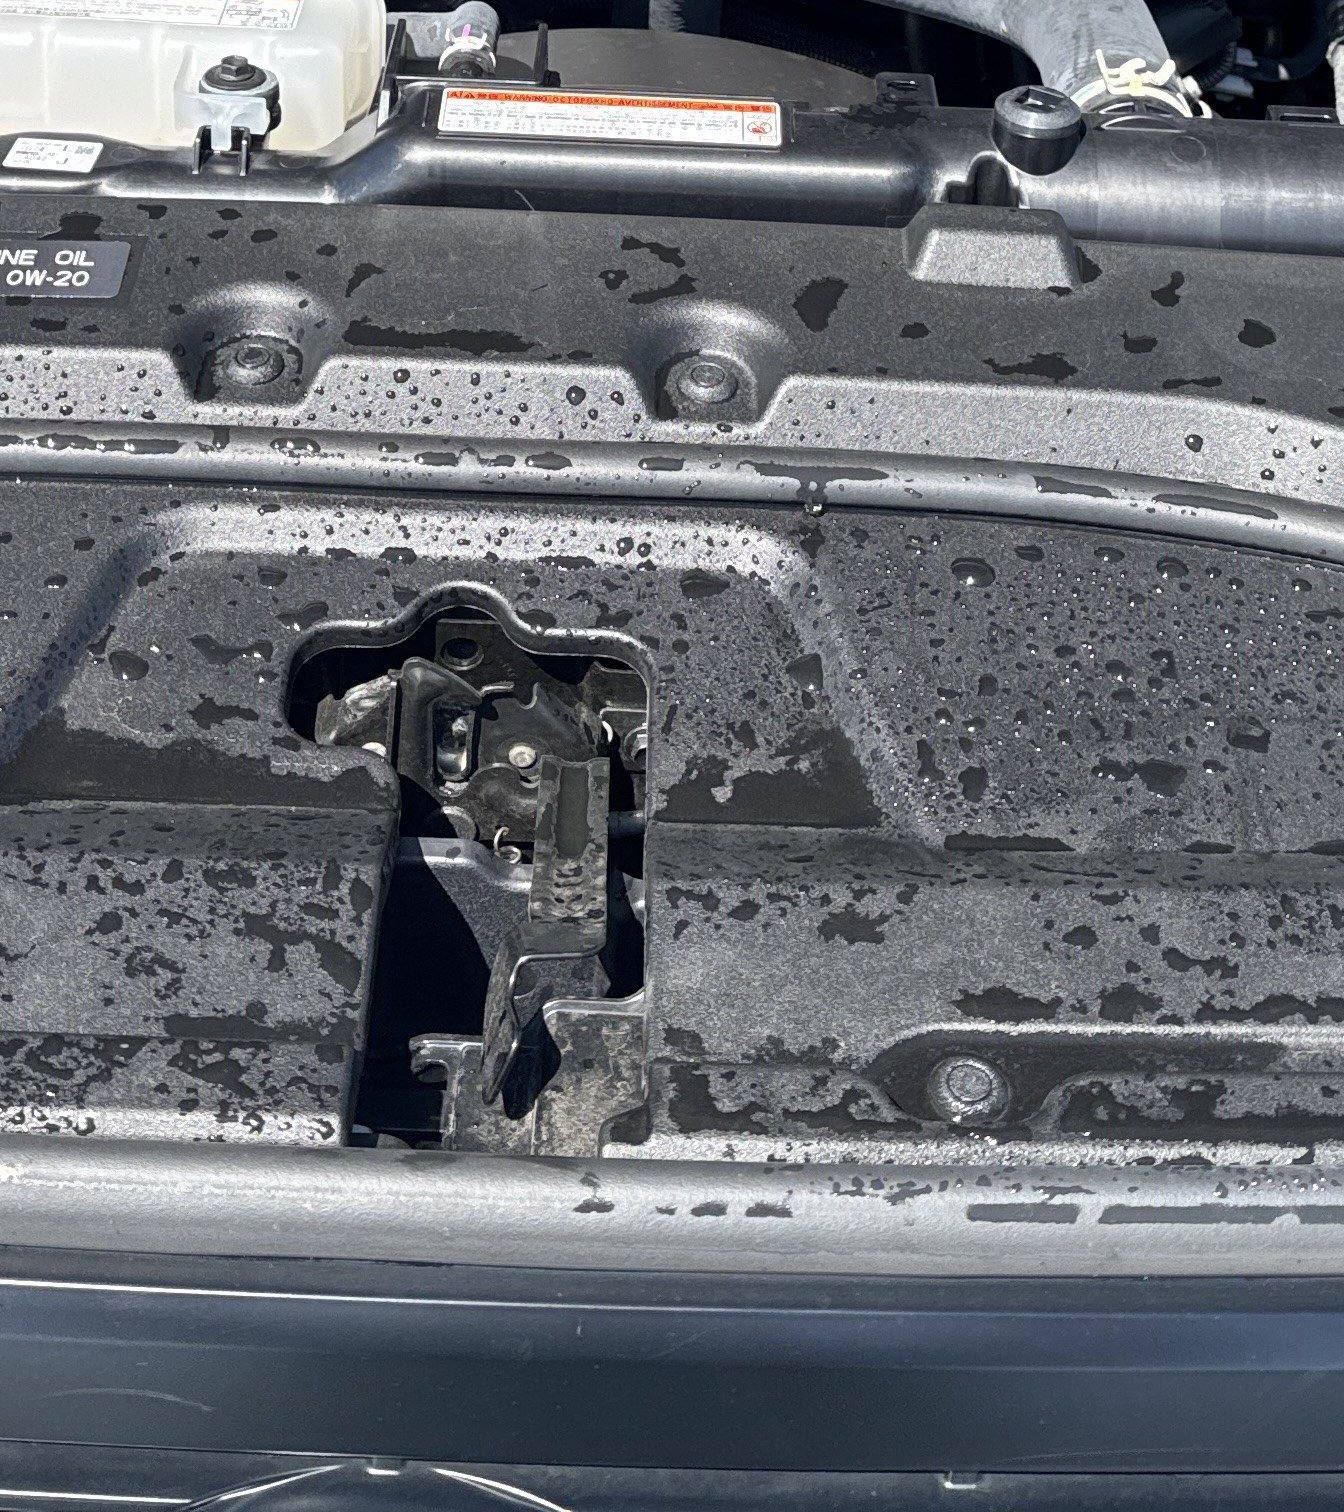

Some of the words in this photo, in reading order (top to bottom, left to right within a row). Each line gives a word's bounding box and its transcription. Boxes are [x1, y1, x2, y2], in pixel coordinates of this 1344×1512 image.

[504, 93, 548, 102] WARNING
[617, 98, 692, 108] AVERTISSEMENT
[55, 250, 95, 267] OIL
[6, 270, 90, 287] 0W-20
